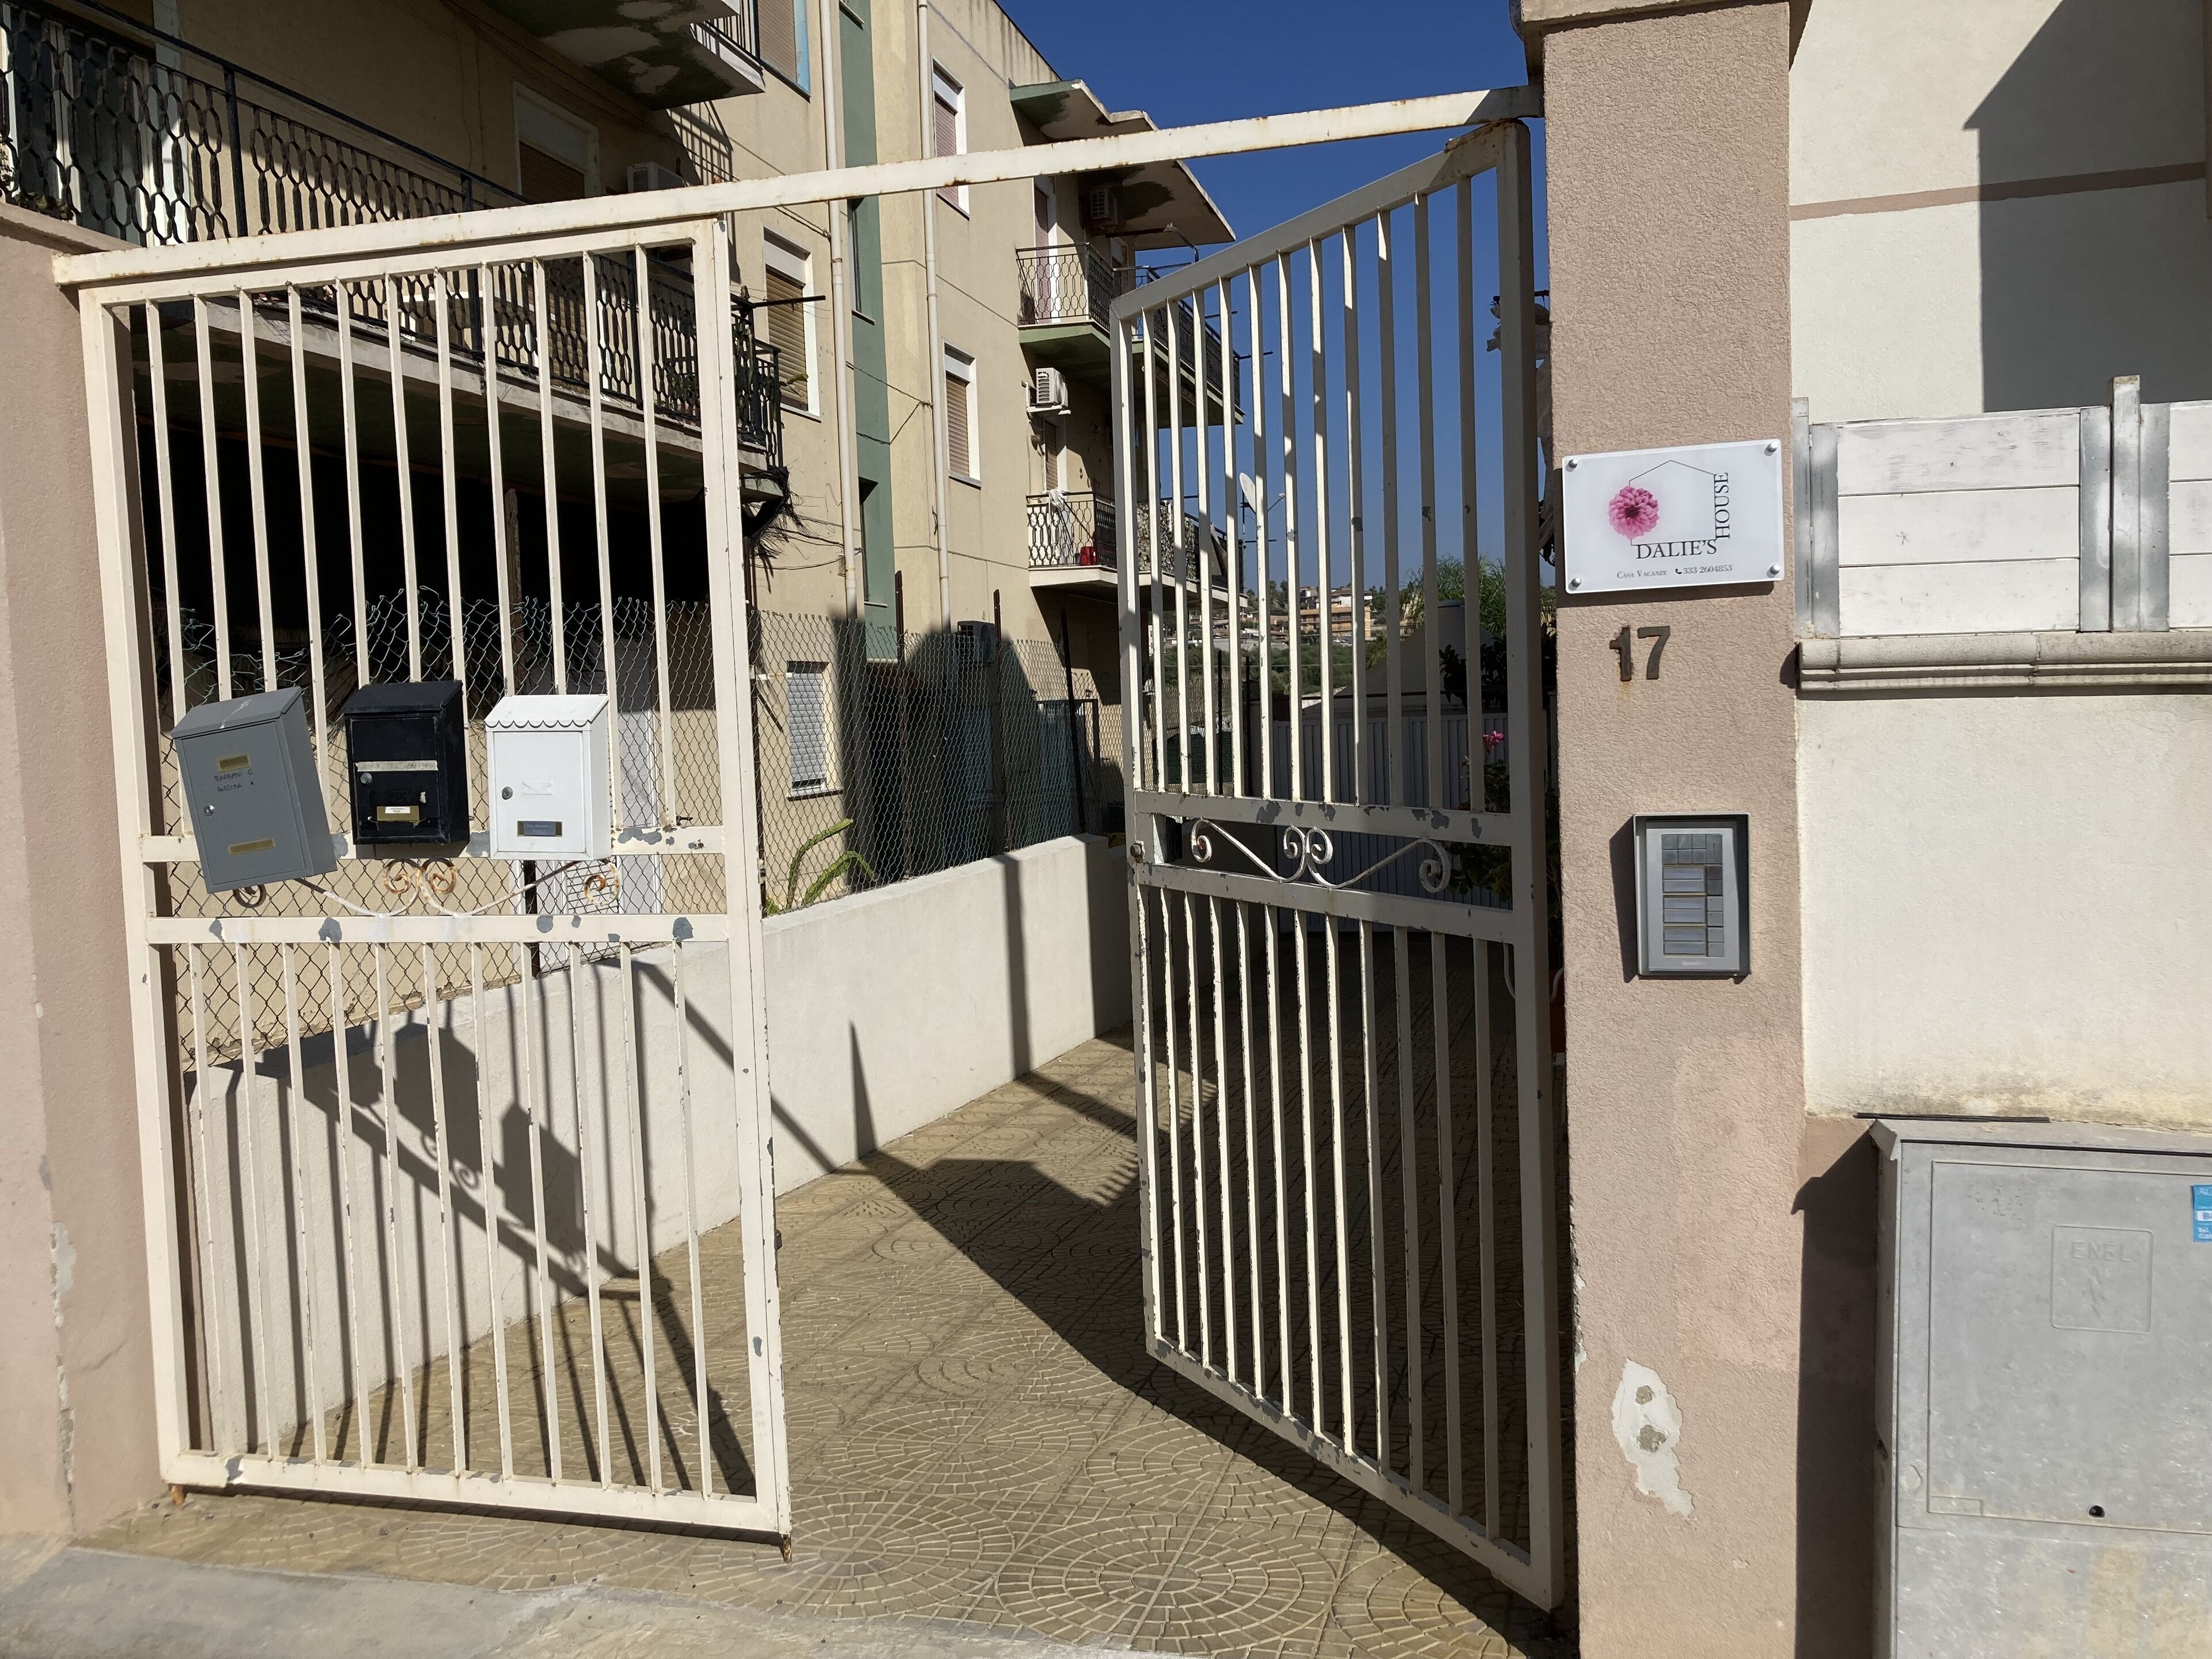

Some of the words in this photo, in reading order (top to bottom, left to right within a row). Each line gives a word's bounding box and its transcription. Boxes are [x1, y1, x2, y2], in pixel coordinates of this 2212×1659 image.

[1714, 472, 1730, 539] HOUSE
[1635, 539, 1717, 559] DALIE'S
[1683, 566, 1698, 574] 333
[1609, 625, 1671, 682] 17
[2070, 1240, 2133, 1263] ENEL
